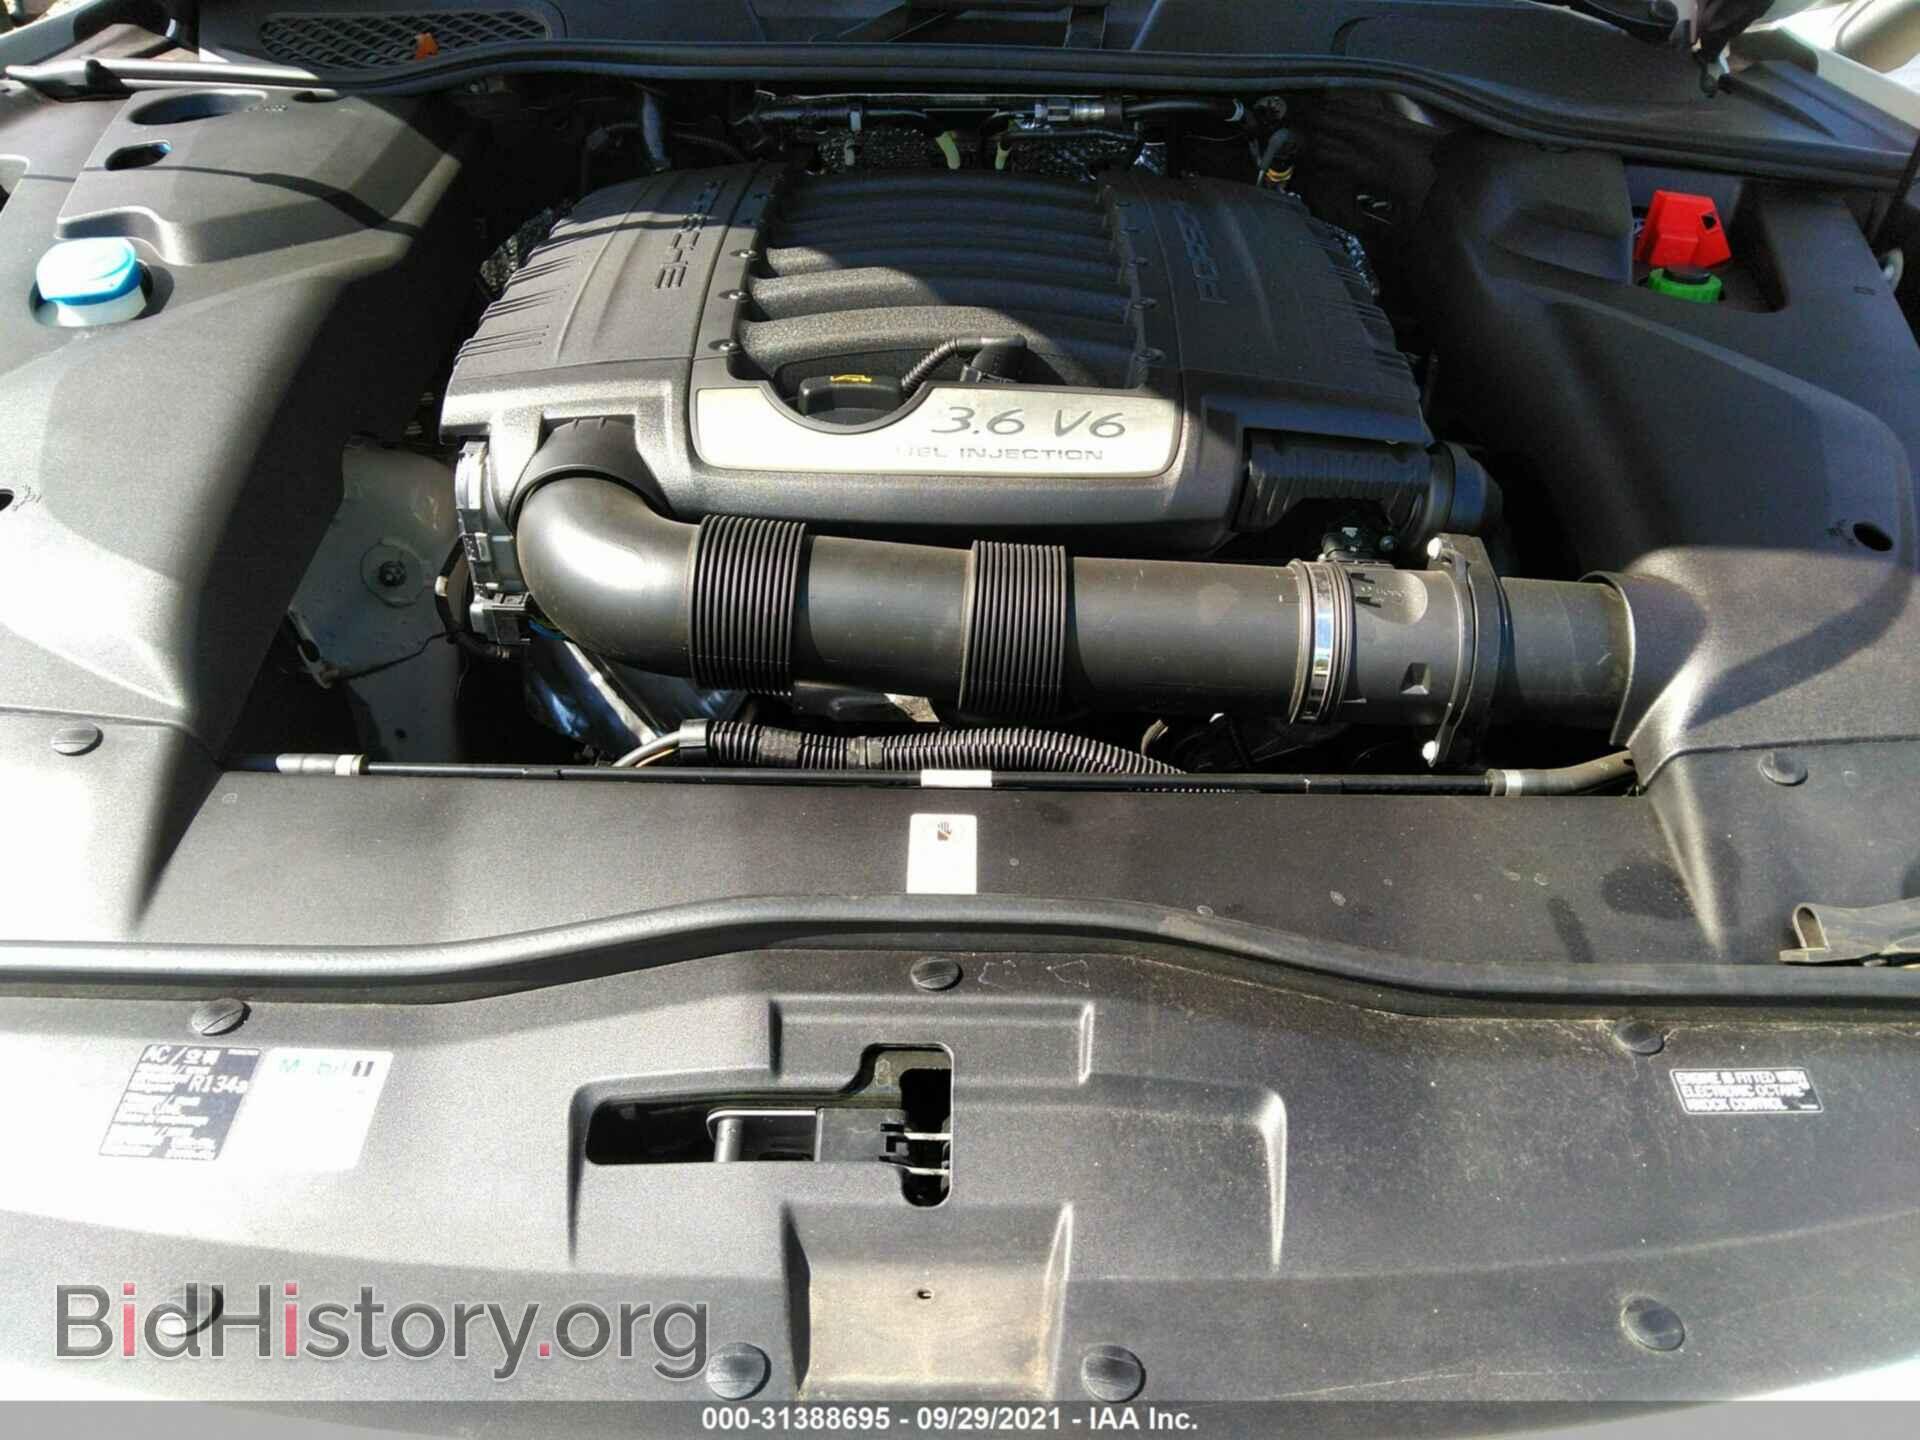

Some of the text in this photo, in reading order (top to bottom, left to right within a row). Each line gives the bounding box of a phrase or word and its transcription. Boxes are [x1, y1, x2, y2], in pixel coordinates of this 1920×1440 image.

[931, 406, 1126, 438] 3.6 V6
[959, 447, 1103, 461] INJECTION
